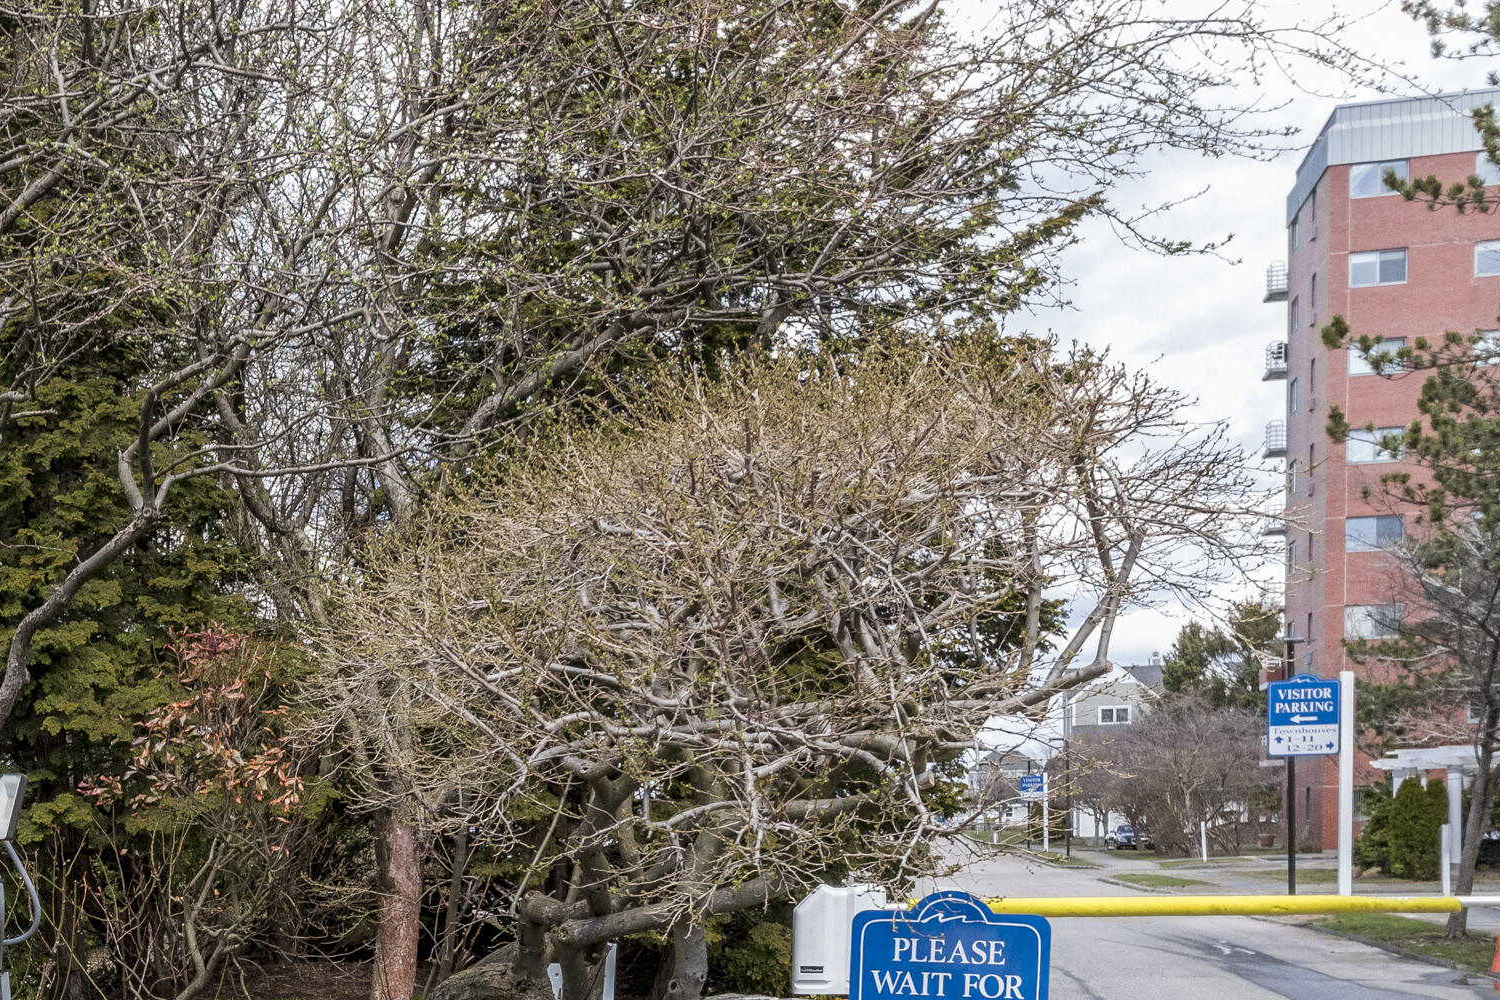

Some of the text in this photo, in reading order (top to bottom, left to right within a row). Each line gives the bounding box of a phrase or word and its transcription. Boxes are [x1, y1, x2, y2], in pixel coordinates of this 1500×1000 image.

[1278, 688, 1332, 700] VISITOR
[1275, 701, 1334, 714] PARKING
[891, 936, 1006, 966] PLEASE
[870, 969, 1025, 1000] WAIT FOR
